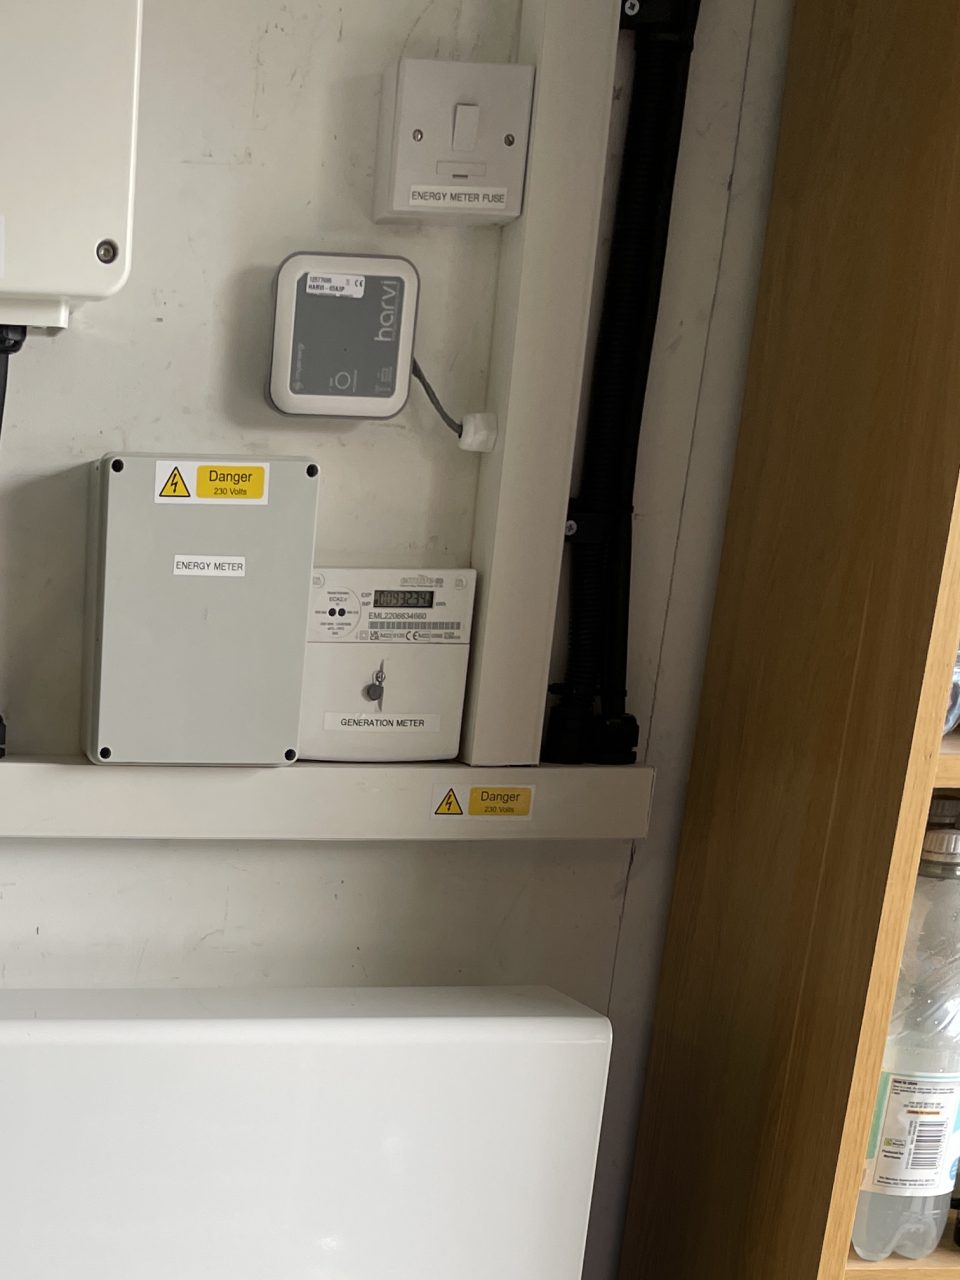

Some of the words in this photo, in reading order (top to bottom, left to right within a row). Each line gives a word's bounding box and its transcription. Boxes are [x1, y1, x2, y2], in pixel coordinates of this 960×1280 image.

[411, 191, 448, 201] ENERGY
[449, 192, 480, 203] METER
[482, 194, 505, 204] FUSE
[374, 280, 399, 342] harvi
[208, 470, 253, 485] Danger
[214, 487, 228, 496] 230
[229, 488, 248, 496] Volts
[175, 560, 212, 571] ENERGY
[214, 562, 244, 572] METER
[340, 718, 394, 728] GENERATION
[396, 719, 425, 728] METER
[480, 790, 521, 804] Danger
